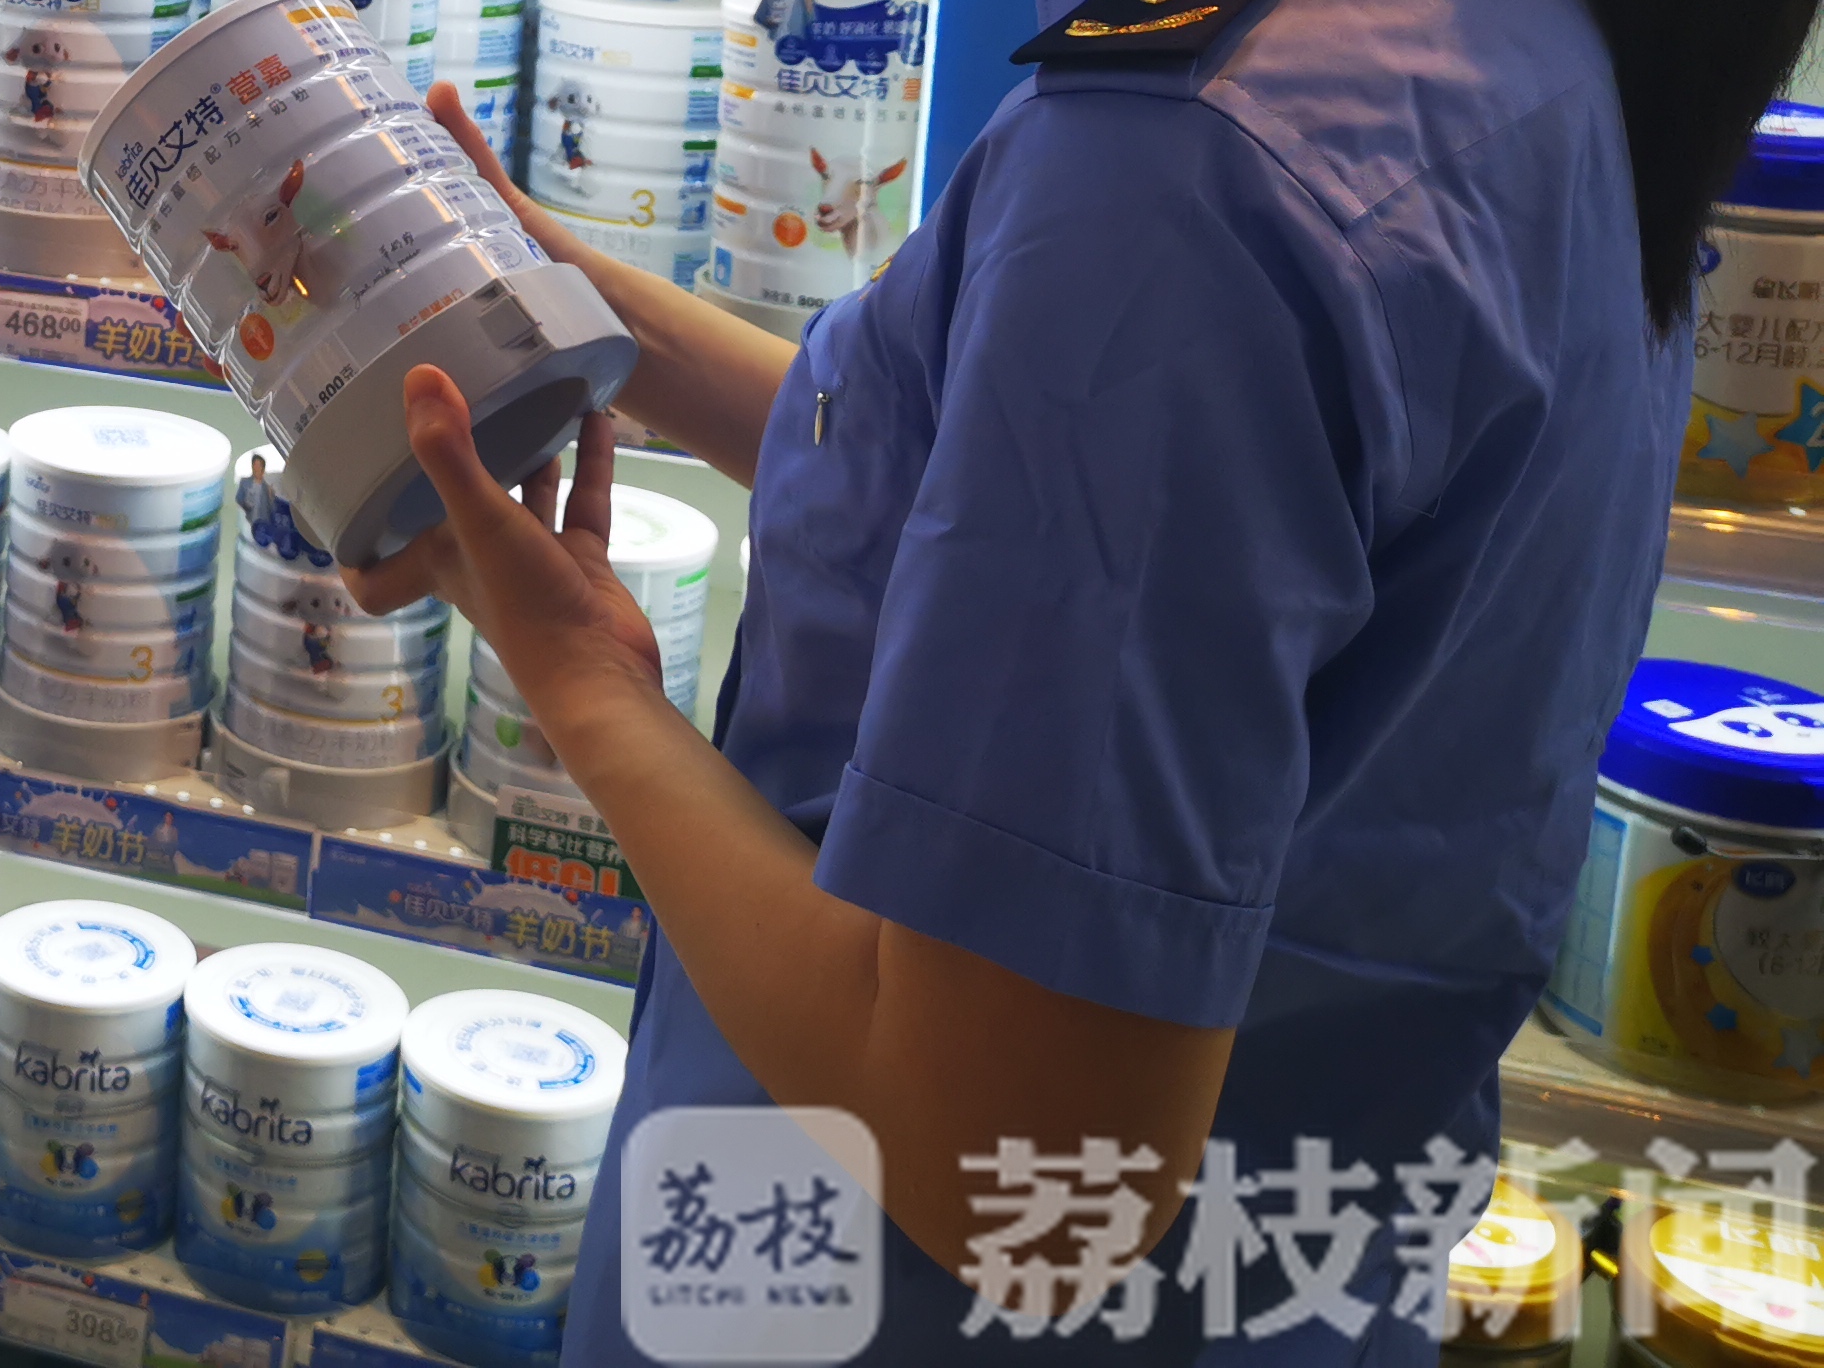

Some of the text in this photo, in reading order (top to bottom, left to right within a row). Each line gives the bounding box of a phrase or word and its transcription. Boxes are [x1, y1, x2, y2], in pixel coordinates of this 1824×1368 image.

[776, 68, 890, 101] 佳贝艾特
[126, 93, 225, 210] 佳贝艾特
[225, 52, 294, 107] 营嘉
[115, 141, 144, 181] kabrita
[629, 189, 657, 228] 3
[5, 309, 81, 340] 468.00
[94, 319, 193, 363] 羊奶节
[128, 646, 153, 682] 3
[382, 686, 405, 723] 3
[54, 818, 148, 865] 羊奶节
[506, 911, 614, 962] 羊奶节
[15, 1045, 132, 1094] kabrita
[201, 1089, 313, 1147] kabrita
[450, 1144, 576, 1202] kabrita
